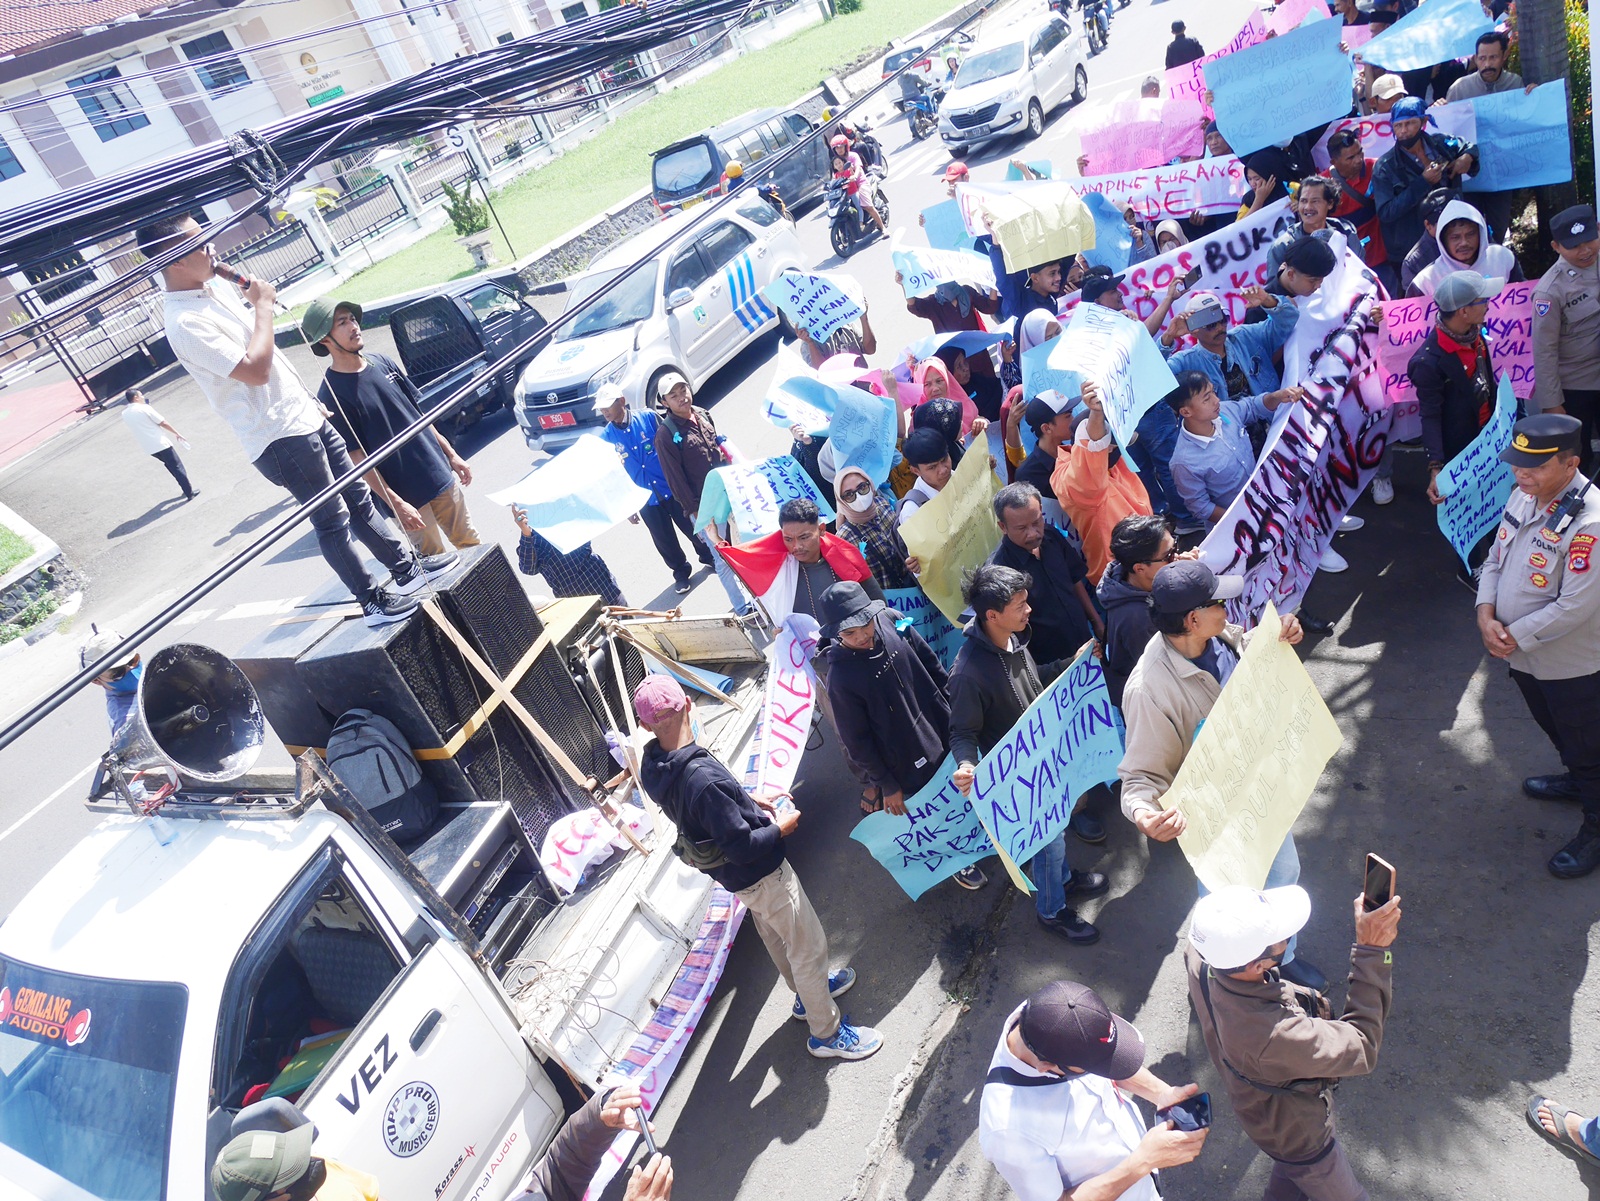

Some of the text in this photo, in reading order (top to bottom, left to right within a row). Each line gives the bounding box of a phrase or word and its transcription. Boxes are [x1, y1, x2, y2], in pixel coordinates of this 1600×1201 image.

[1566, 292, 1589, 309] TOYA
[1531, 536, 1558, 555] POLRI
[973, 707, 1047, 801] UDAH
[989, 698, 1115, 842] NYAKITIN
[893, 821, 949, 856] PAK
[1010, 782, 1071, 863] GAMM
[9, 1014, 61, 1039] AUDIO
[14, 986, 72, 1025] GEMILANG
[335, 1032, 399, 1116] VEZ
[386, 1086, 433, 1146] TOPP PRO
[398, 1099, 437, 1154] MUSIC GEAR
[434, 1154, 464, 1199] Korass
